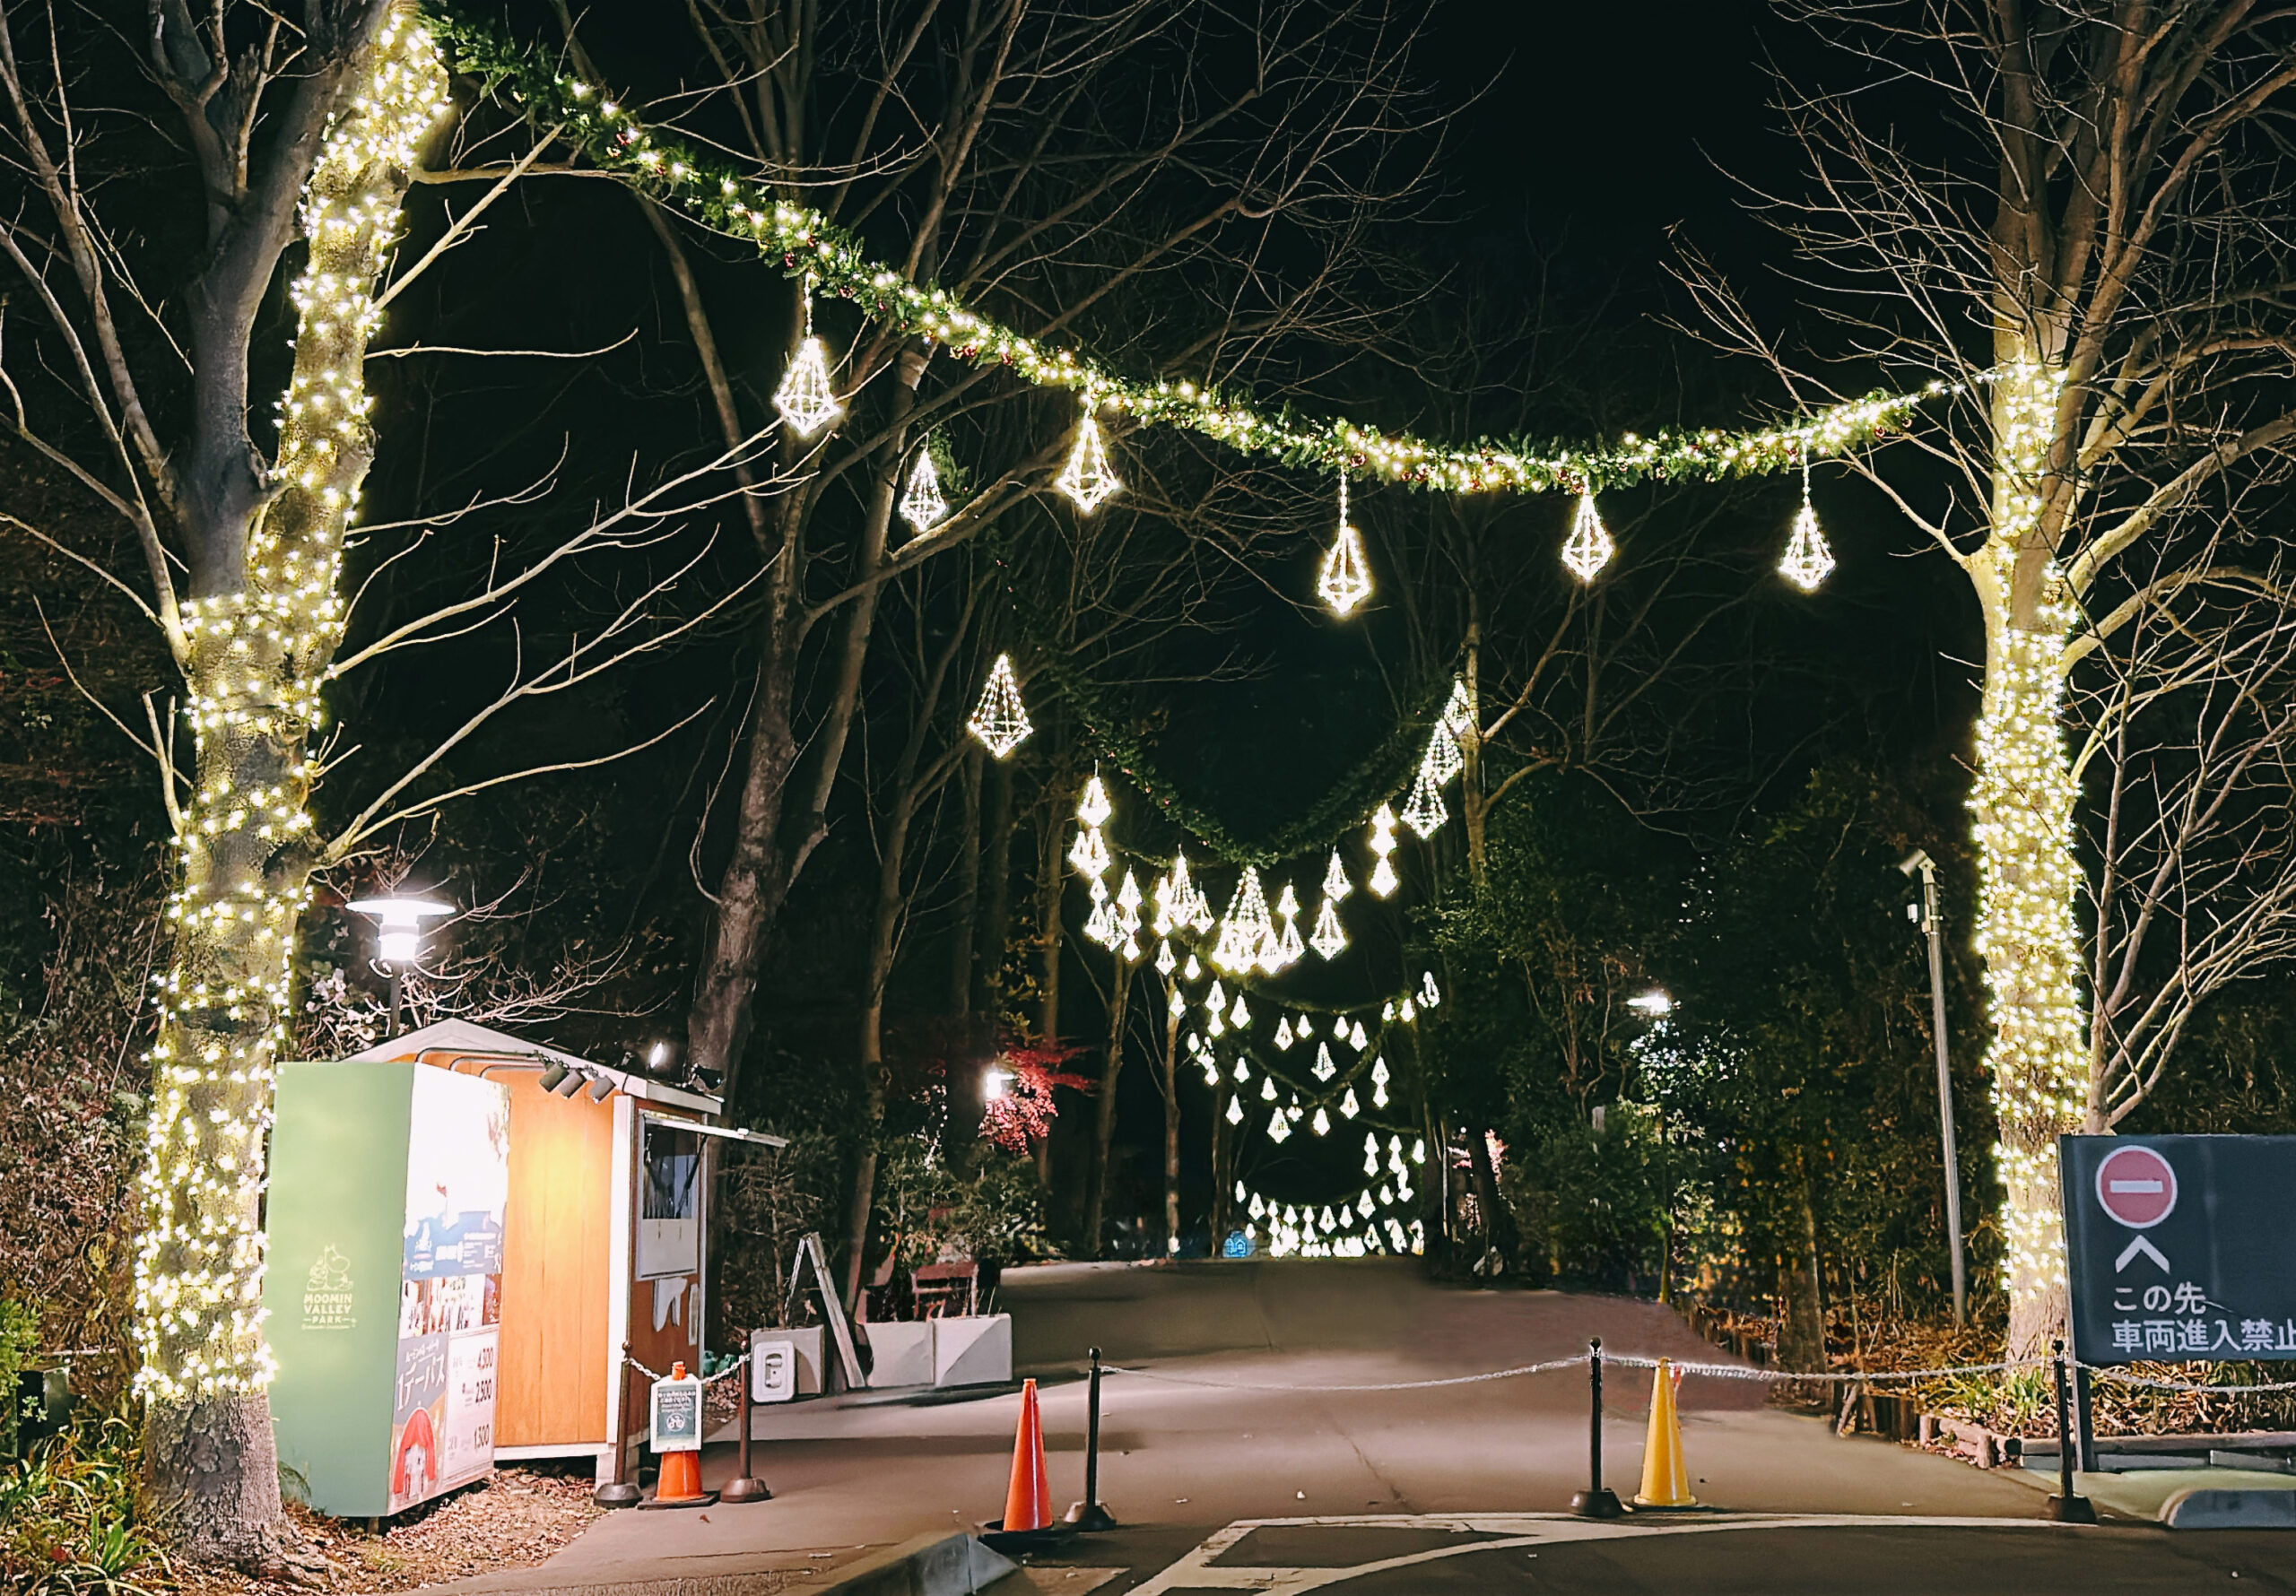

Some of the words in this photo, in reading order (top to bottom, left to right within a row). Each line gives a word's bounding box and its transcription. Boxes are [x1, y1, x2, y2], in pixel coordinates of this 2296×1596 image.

[303, 1293, 352, 1304] MOOMIN
[2113, 1281, 2206, 1314] この先
[304, 1305, 352, 1314] VALLEY
[312, 1315, 342, 1323] PARK
[2111, 1318, 2296, 1353] 車両進入禁止
